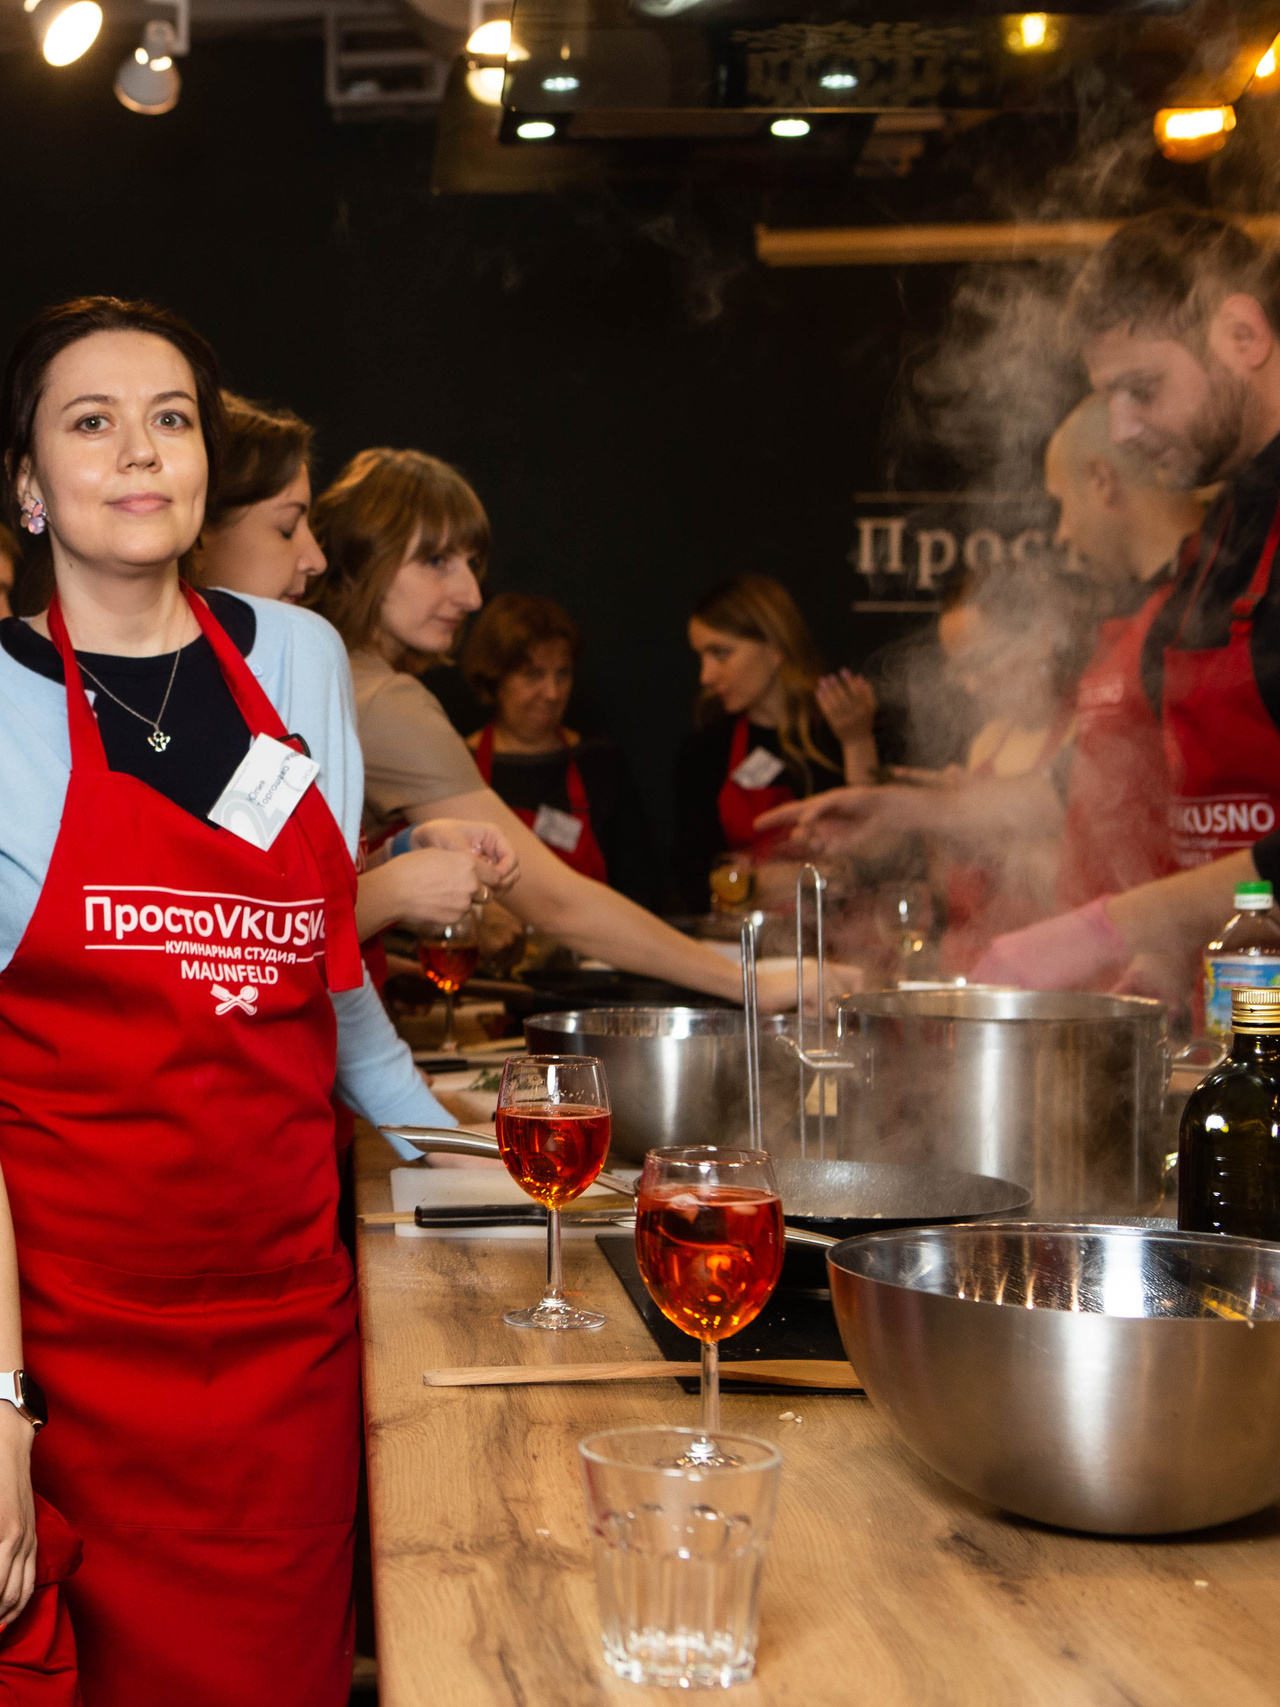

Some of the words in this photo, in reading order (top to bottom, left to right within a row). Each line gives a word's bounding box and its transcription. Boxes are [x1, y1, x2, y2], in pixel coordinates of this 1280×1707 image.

[84, 896, 325, 946] ПростоVKUSN
[165, 940, 241, 960] КУЛИНАРНАЯ
[244, 947, 296, 964] СТУДИЯ
[181, 960, 278, 984] MAUNFELD
